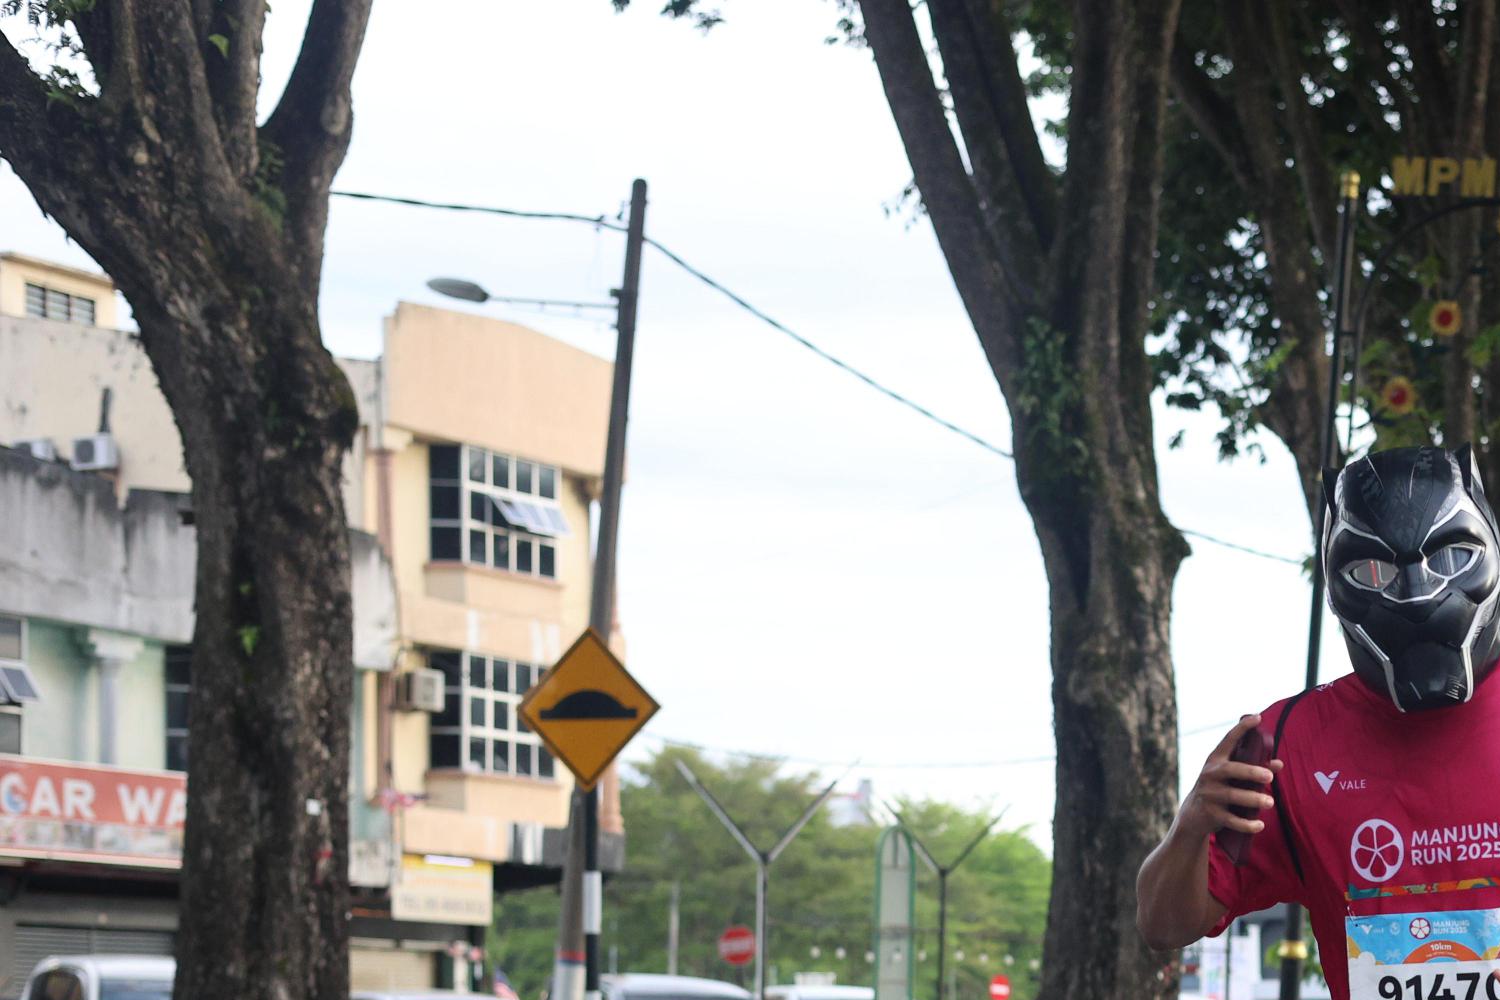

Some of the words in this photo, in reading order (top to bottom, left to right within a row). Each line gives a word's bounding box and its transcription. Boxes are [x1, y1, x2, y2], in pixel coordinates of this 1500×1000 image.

[1391, 156, 1497, 196] MPM
[1340, 779, 1367, 790] VALE
[1411, 845, 1452, 866] RUN
[1430, 942, 1452, 951] 10km
